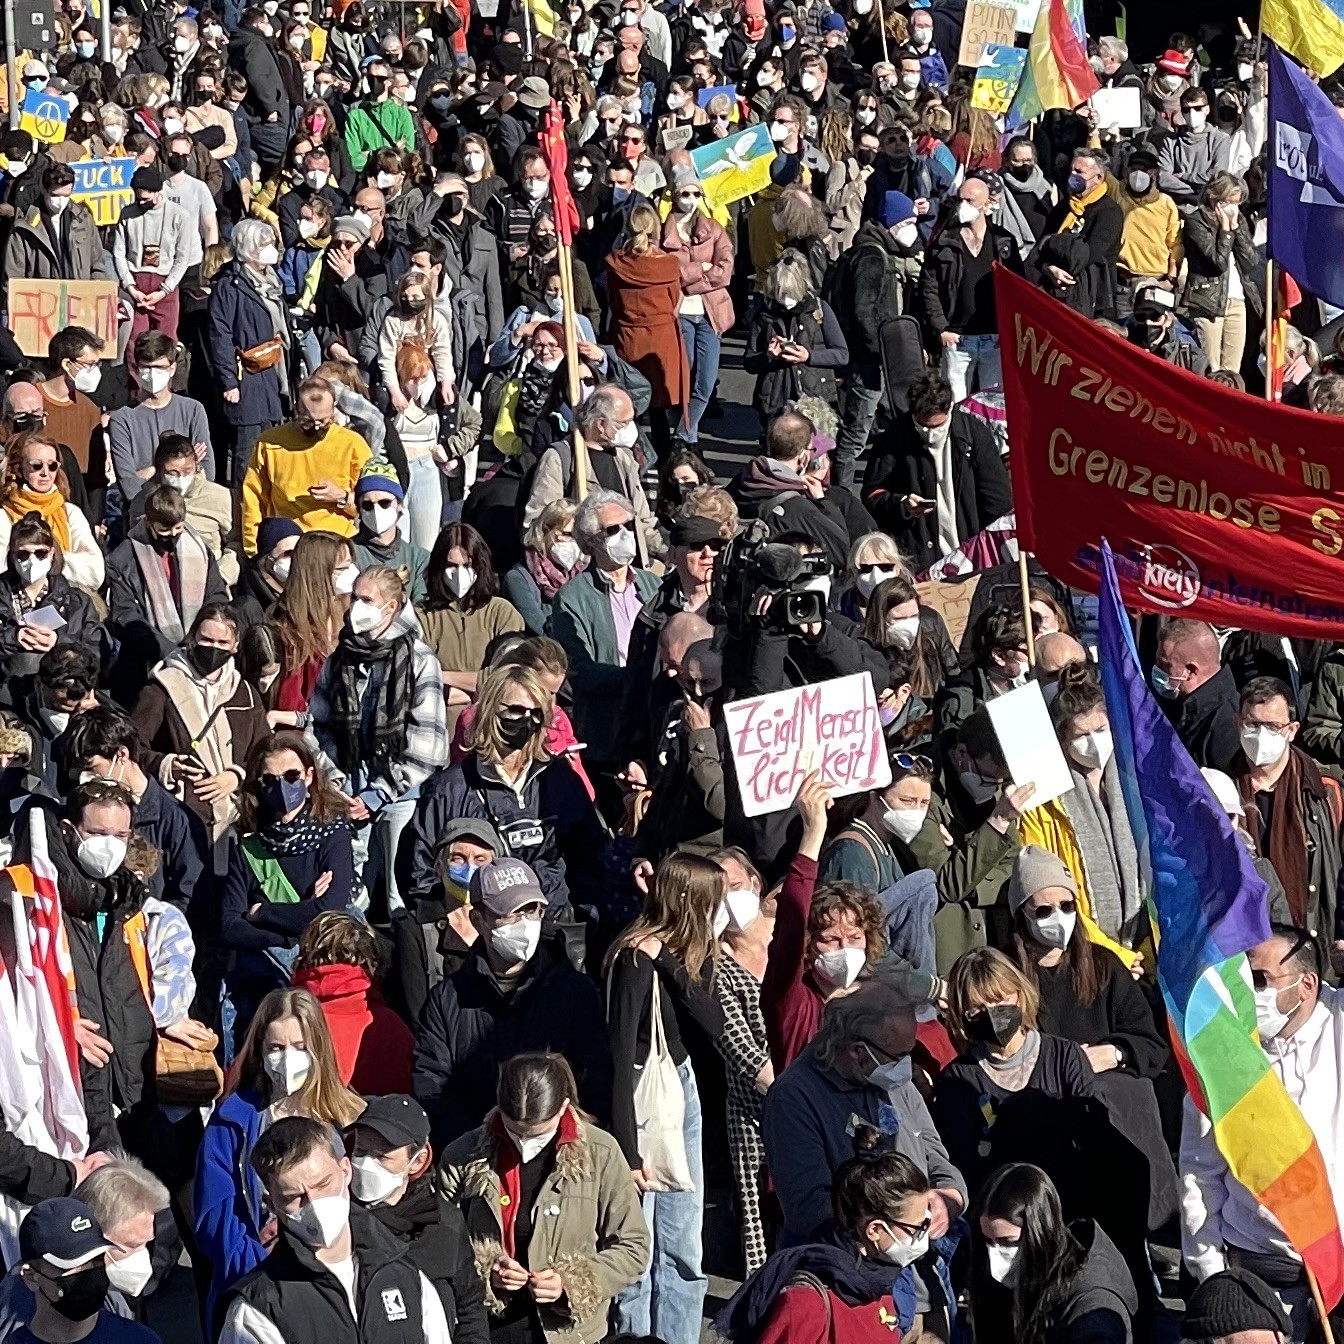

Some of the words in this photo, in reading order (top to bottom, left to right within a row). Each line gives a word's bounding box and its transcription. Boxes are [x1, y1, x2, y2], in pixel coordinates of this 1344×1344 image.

[971, 3, 1017, 31] PUTIN
[72, 164, 125, 188] FUCK
[1014, 312, 1073, 386] Wir
[1206, 426, 1287, 477] nicht
[1297, 447, 1332, 491] in
[1048, 426, 1282, 534] Grenzenlose
[728, 696, 800, 758] Zeigt
[799, 674, 877, 752] Mensch
[493, 866, 526, 881] HUGO
[497, 874, 530, 891] BOSS
